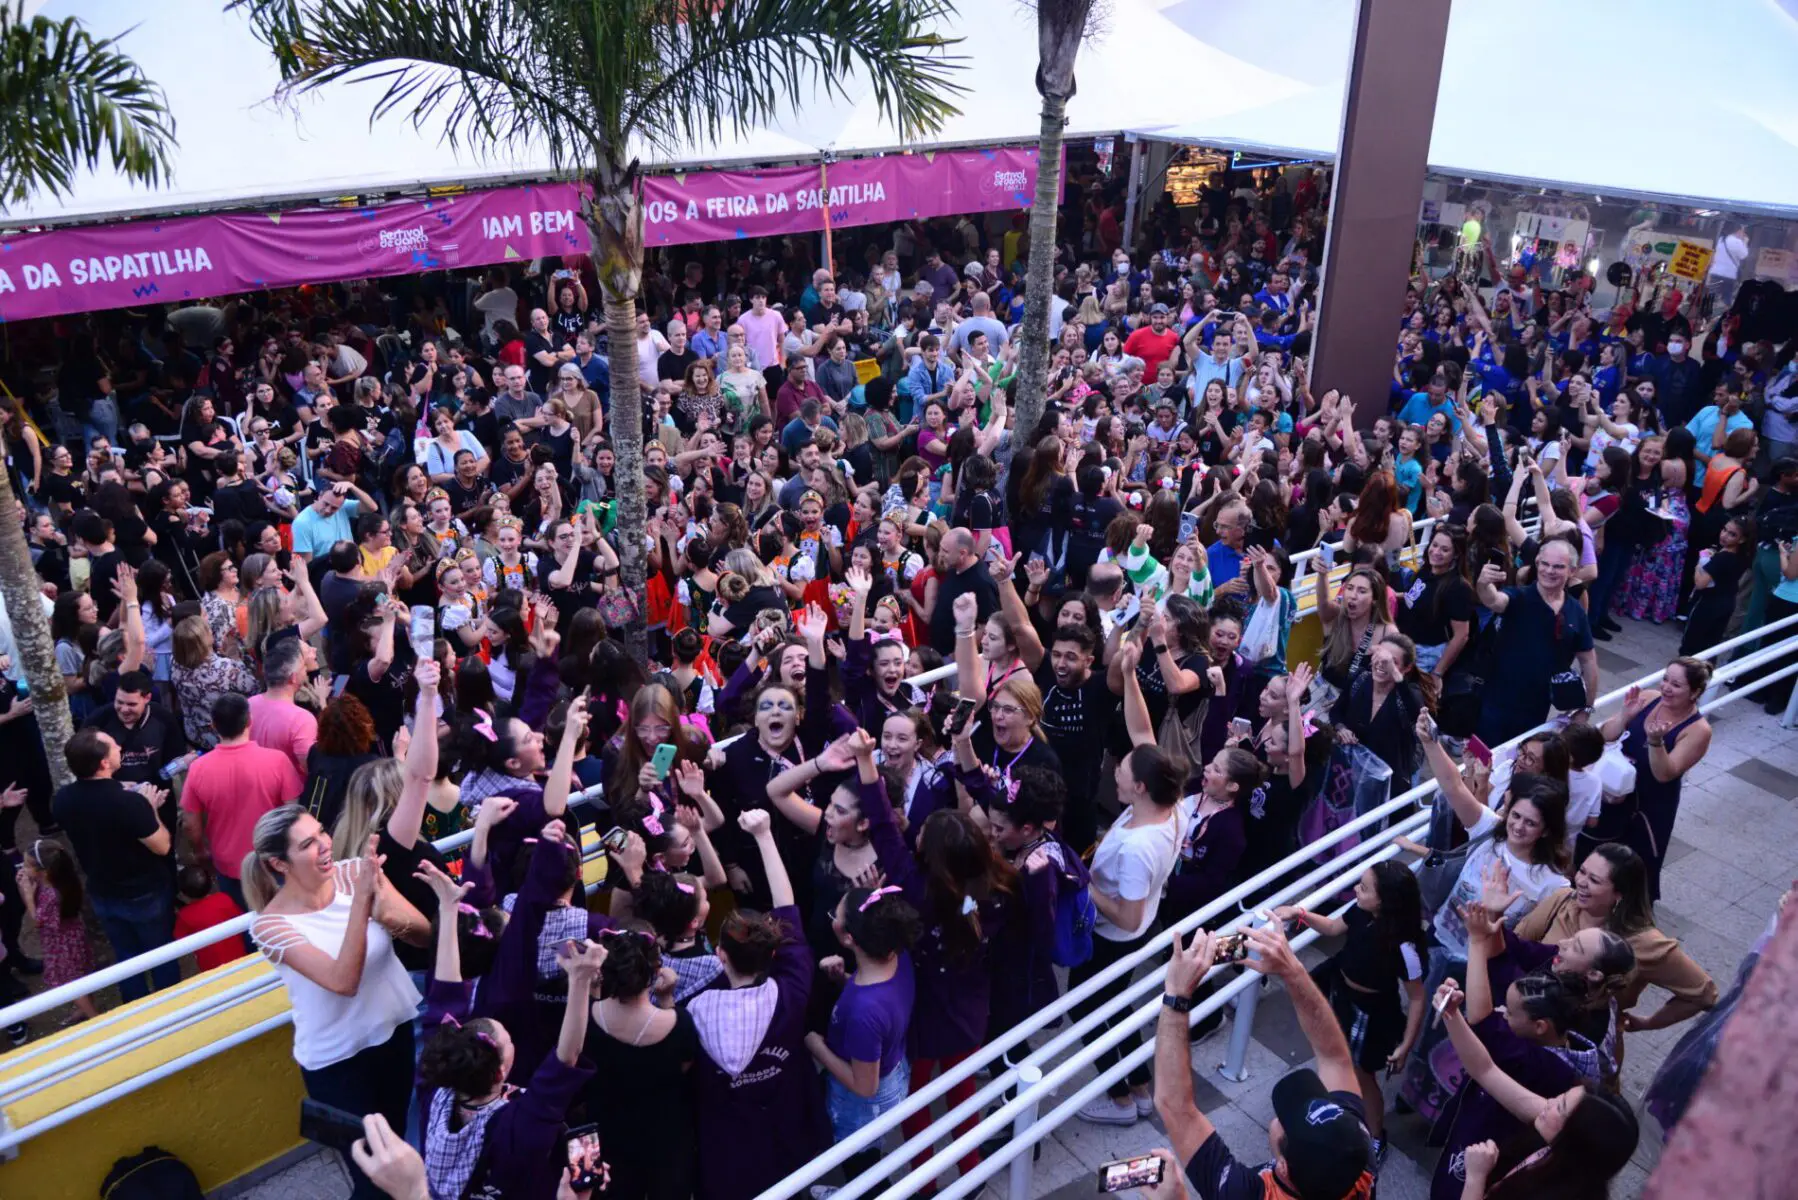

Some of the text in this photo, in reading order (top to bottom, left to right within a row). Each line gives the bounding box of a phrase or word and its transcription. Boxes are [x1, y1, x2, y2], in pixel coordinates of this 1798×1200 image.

[530, 209, 575, 236] BEM
[685, 199, 699, 221] A
[706, 194, 759, 219] FEIRA
[765, 192, 789, 214] DA
[0, 247, 213, 294] A DA SAPATILHA
